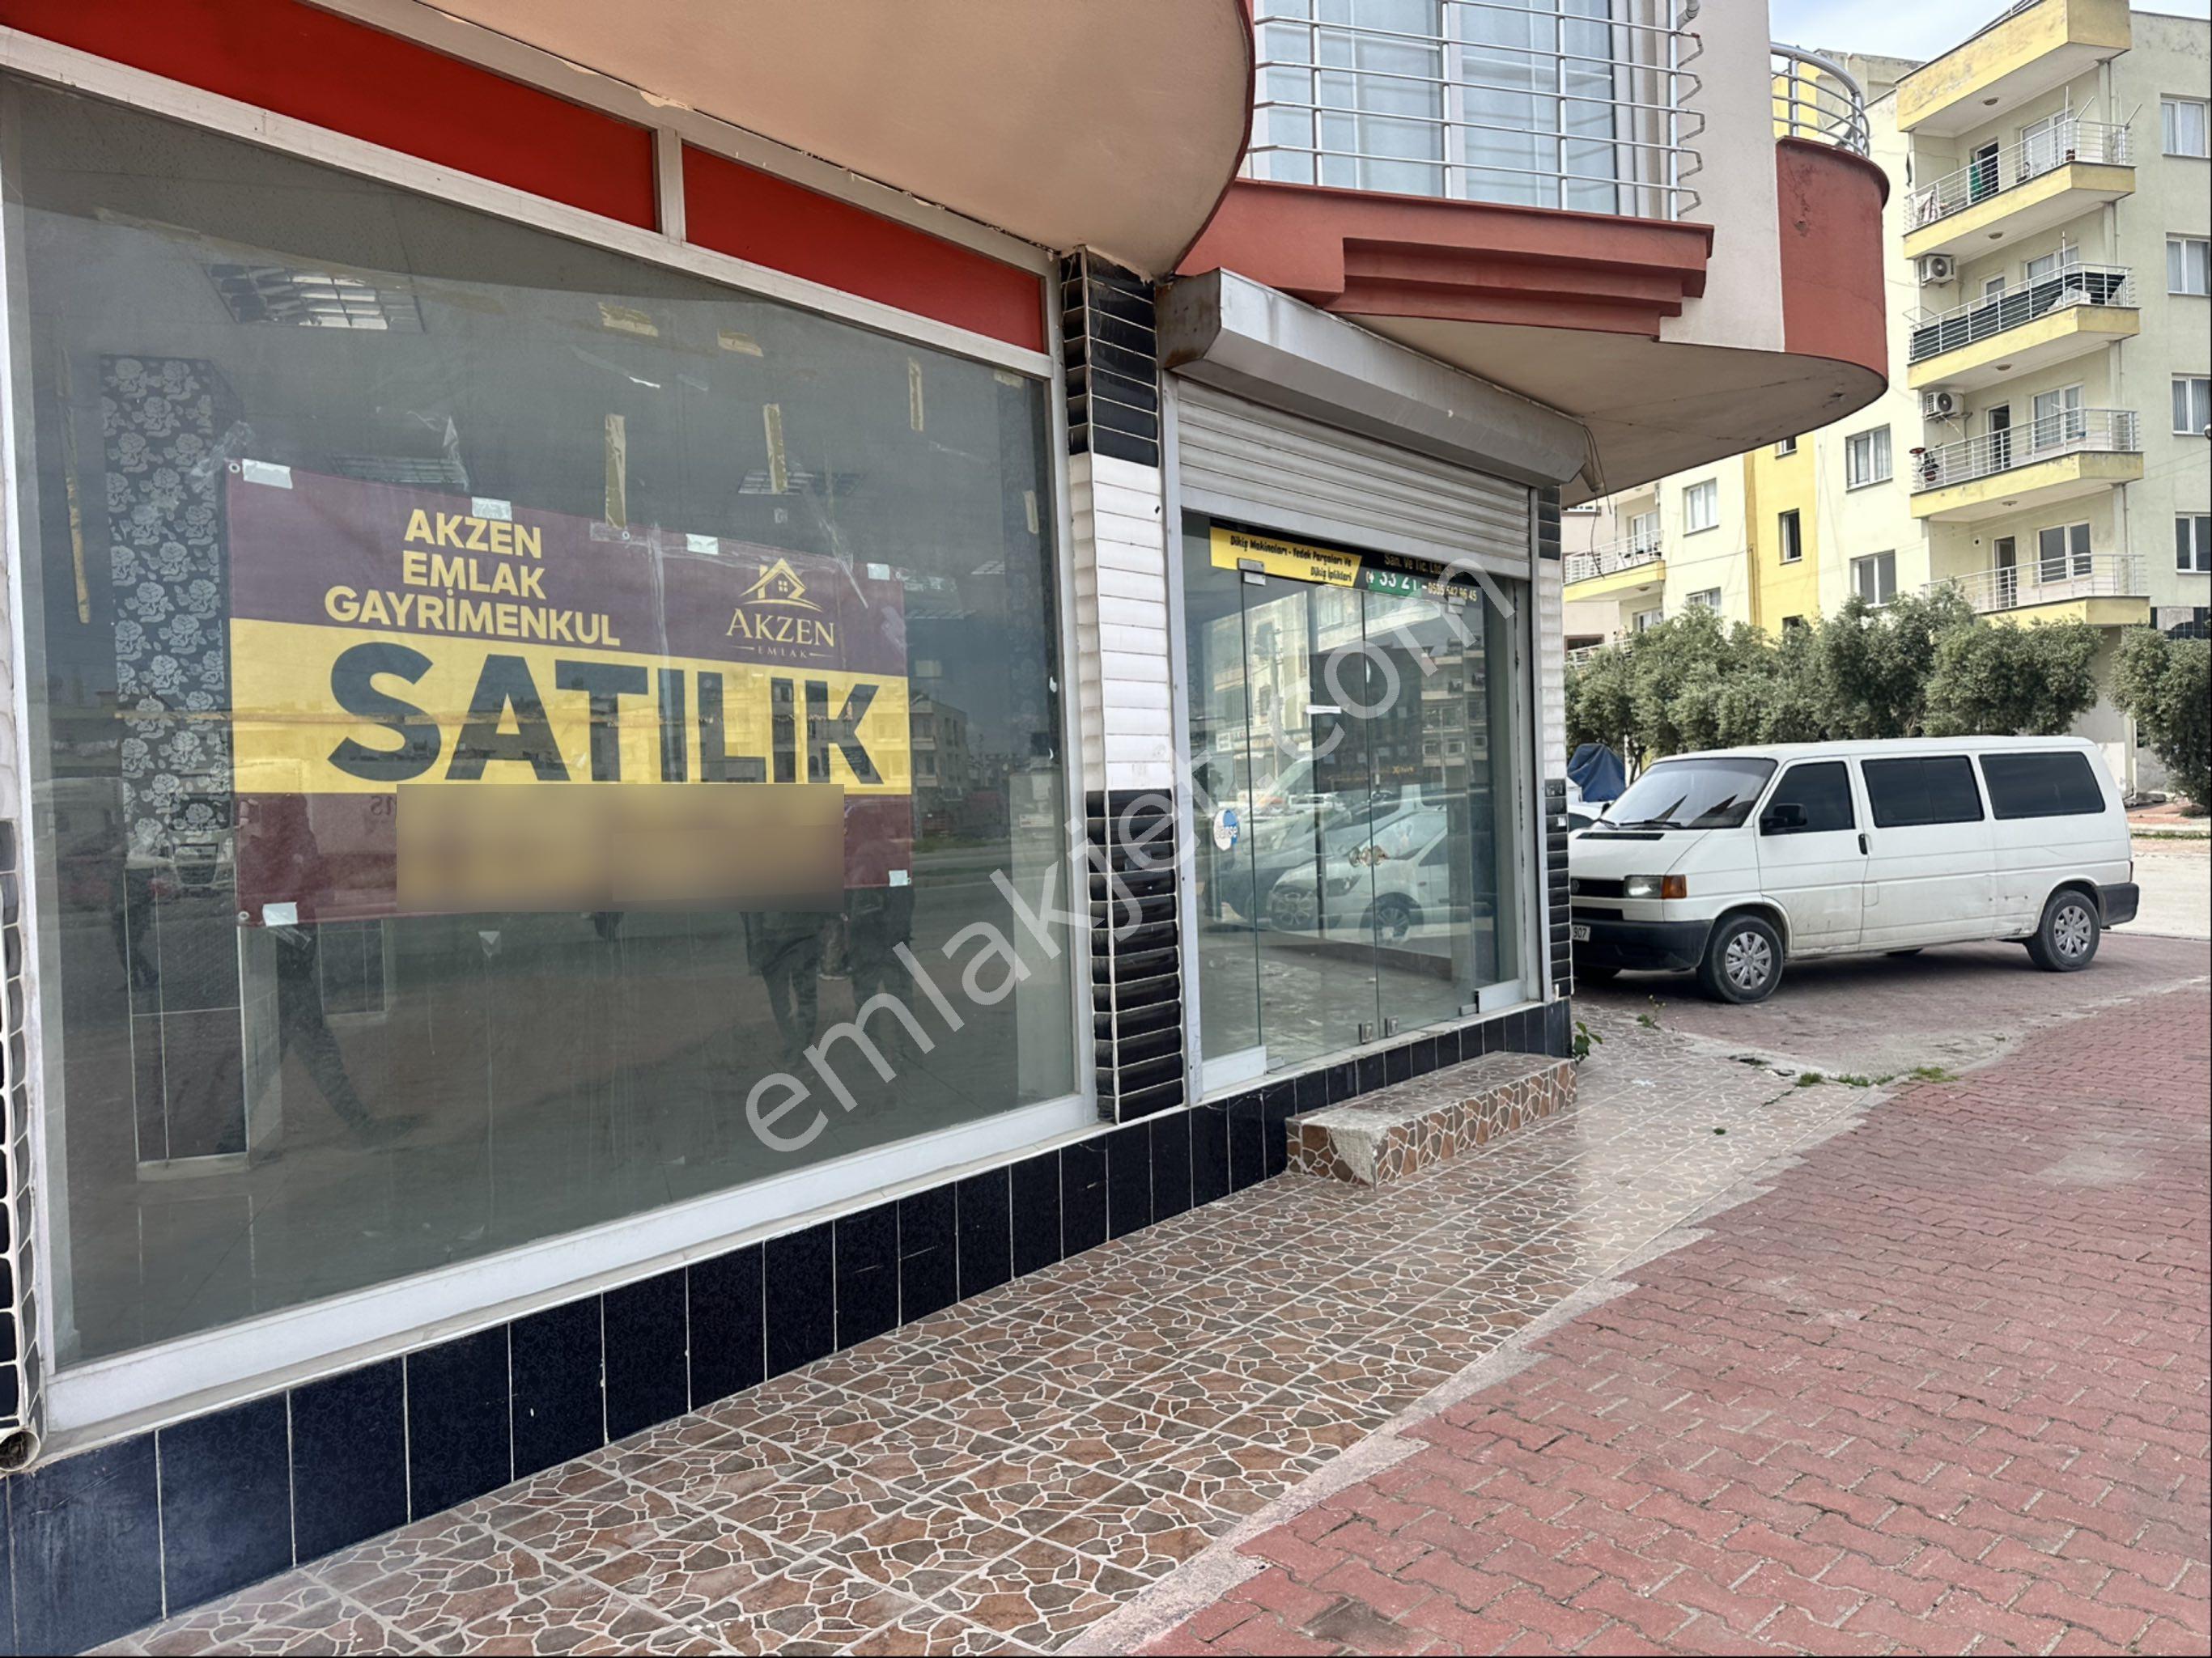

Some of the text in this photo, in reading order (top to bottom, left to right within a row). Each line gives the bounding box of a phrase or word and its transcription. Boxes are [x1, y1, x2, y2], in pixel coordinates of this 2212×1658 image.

[404, 508, 542, 560] AKZEN
[402, 549, 546, 600] EMLAK
[325, 586, 621, 647] GAYRİMENKUL
[726, 608, 835, 647] AKZEN
[758, 646, 808, 659] EMLAK
[328, 641, 884, 785] SATILIK
